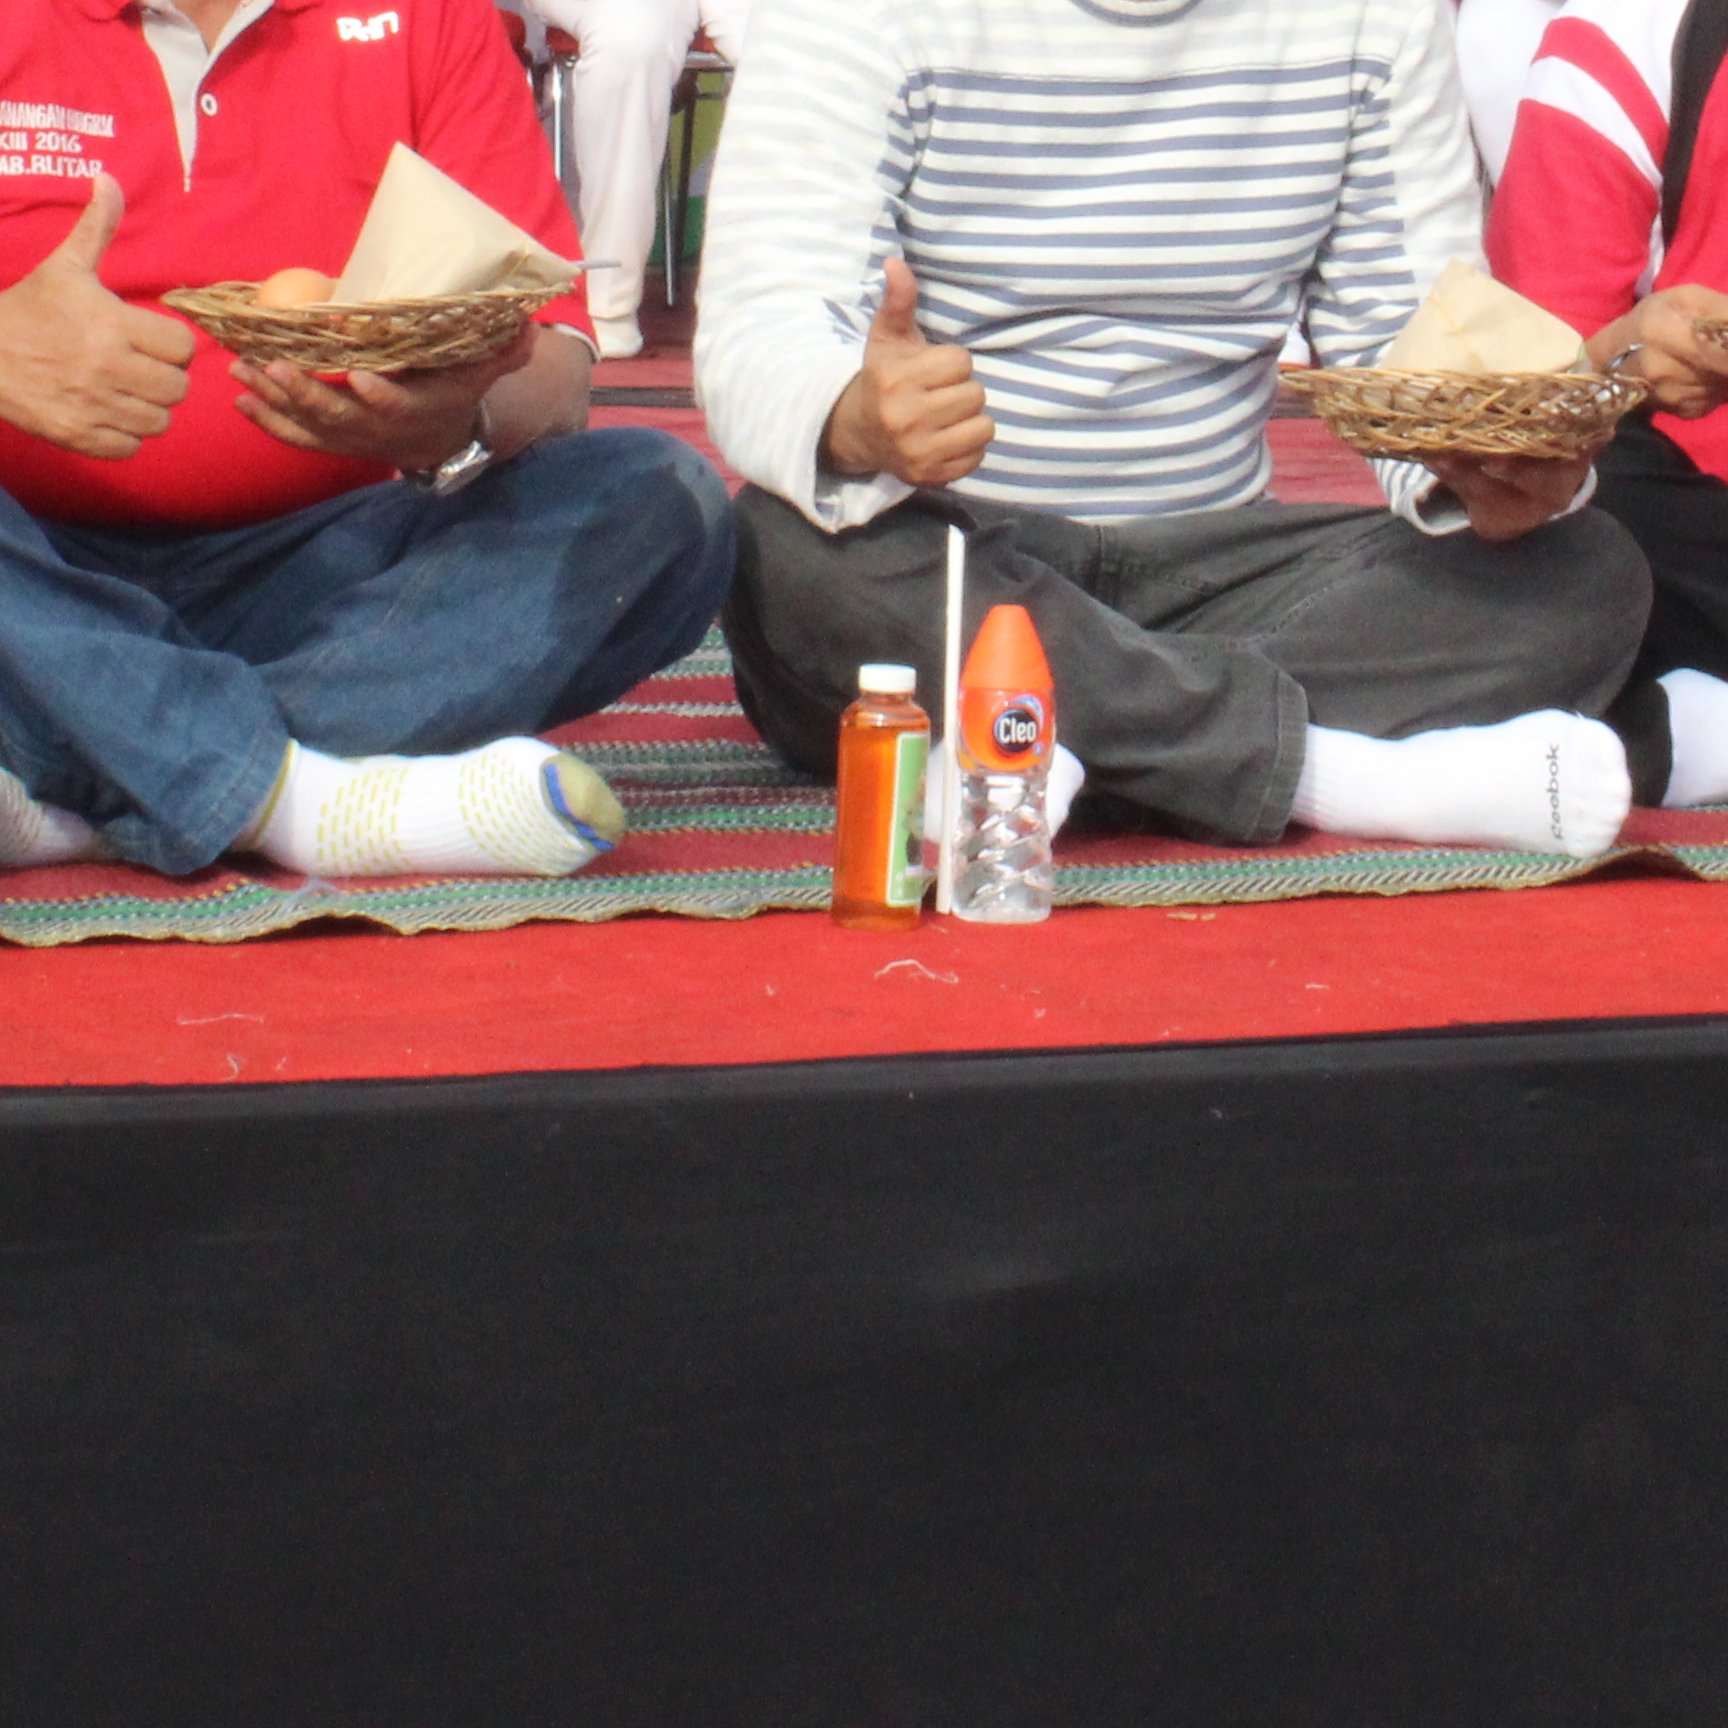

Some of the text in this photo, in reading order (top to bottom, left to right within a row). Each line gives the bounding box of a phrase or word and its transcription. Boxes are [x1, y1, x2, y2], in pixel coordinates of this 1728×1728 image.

[34, 131, 83, 153] 2016
[998, 718, 1037, 744] Cleo
[1545, 742, 1564, 840] Reebok
